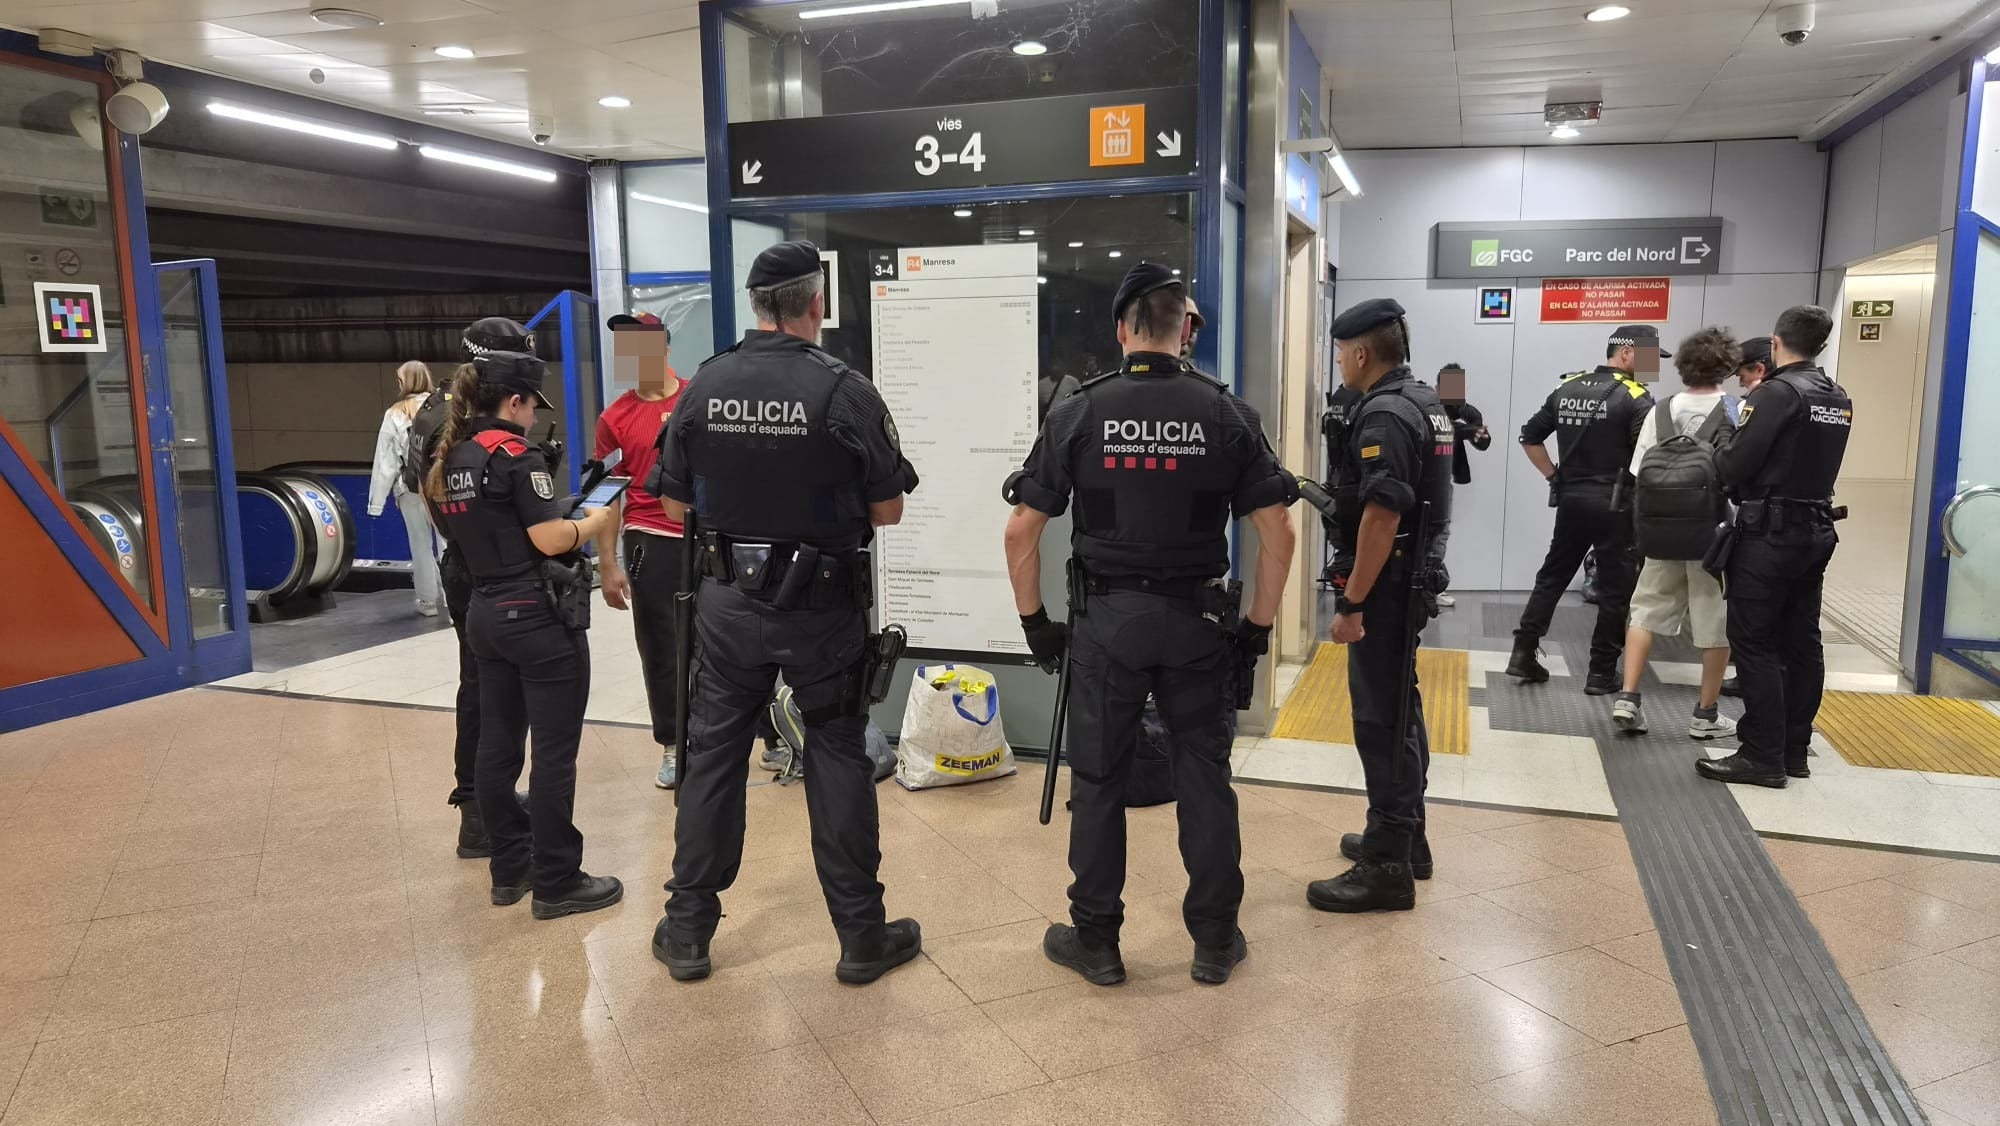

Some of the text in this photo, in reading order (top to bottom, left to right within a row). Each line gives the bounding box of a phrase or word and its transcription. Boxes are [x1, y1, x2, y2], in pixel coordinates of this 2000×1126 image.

[937, 117, 962, 131] vies
[914, 131, 986, 176] 3-4
[1500, 249, 1534, 263] FGC
[1565, 247, 1676, 263] Parc del Nord
[874, 263, 894, 276] 3-4
[923, 258, 956, 267] Manresa
[1545, 283, 1556, 291] EN
[1581, 282, 1592, 290] DE
[1627, 280, 1666, 289] ACTIVADA
[1549, 302, 1560, 310] EN
[1580, 301, 1619, 309] D'ALARMA
[1621, 300, 1660, 308] ACTIVADA
[1581, 310, 1593, 318] NO
[707, 398, 808, 423] POLICIA
[707, 423, 747, 433] mossos
[1103, 419, 1206, 443] POLICIA
[1103, 442, 1206, 456] mossos d'esquadra
[940, 751, 1000, 771] ZEEMAN
